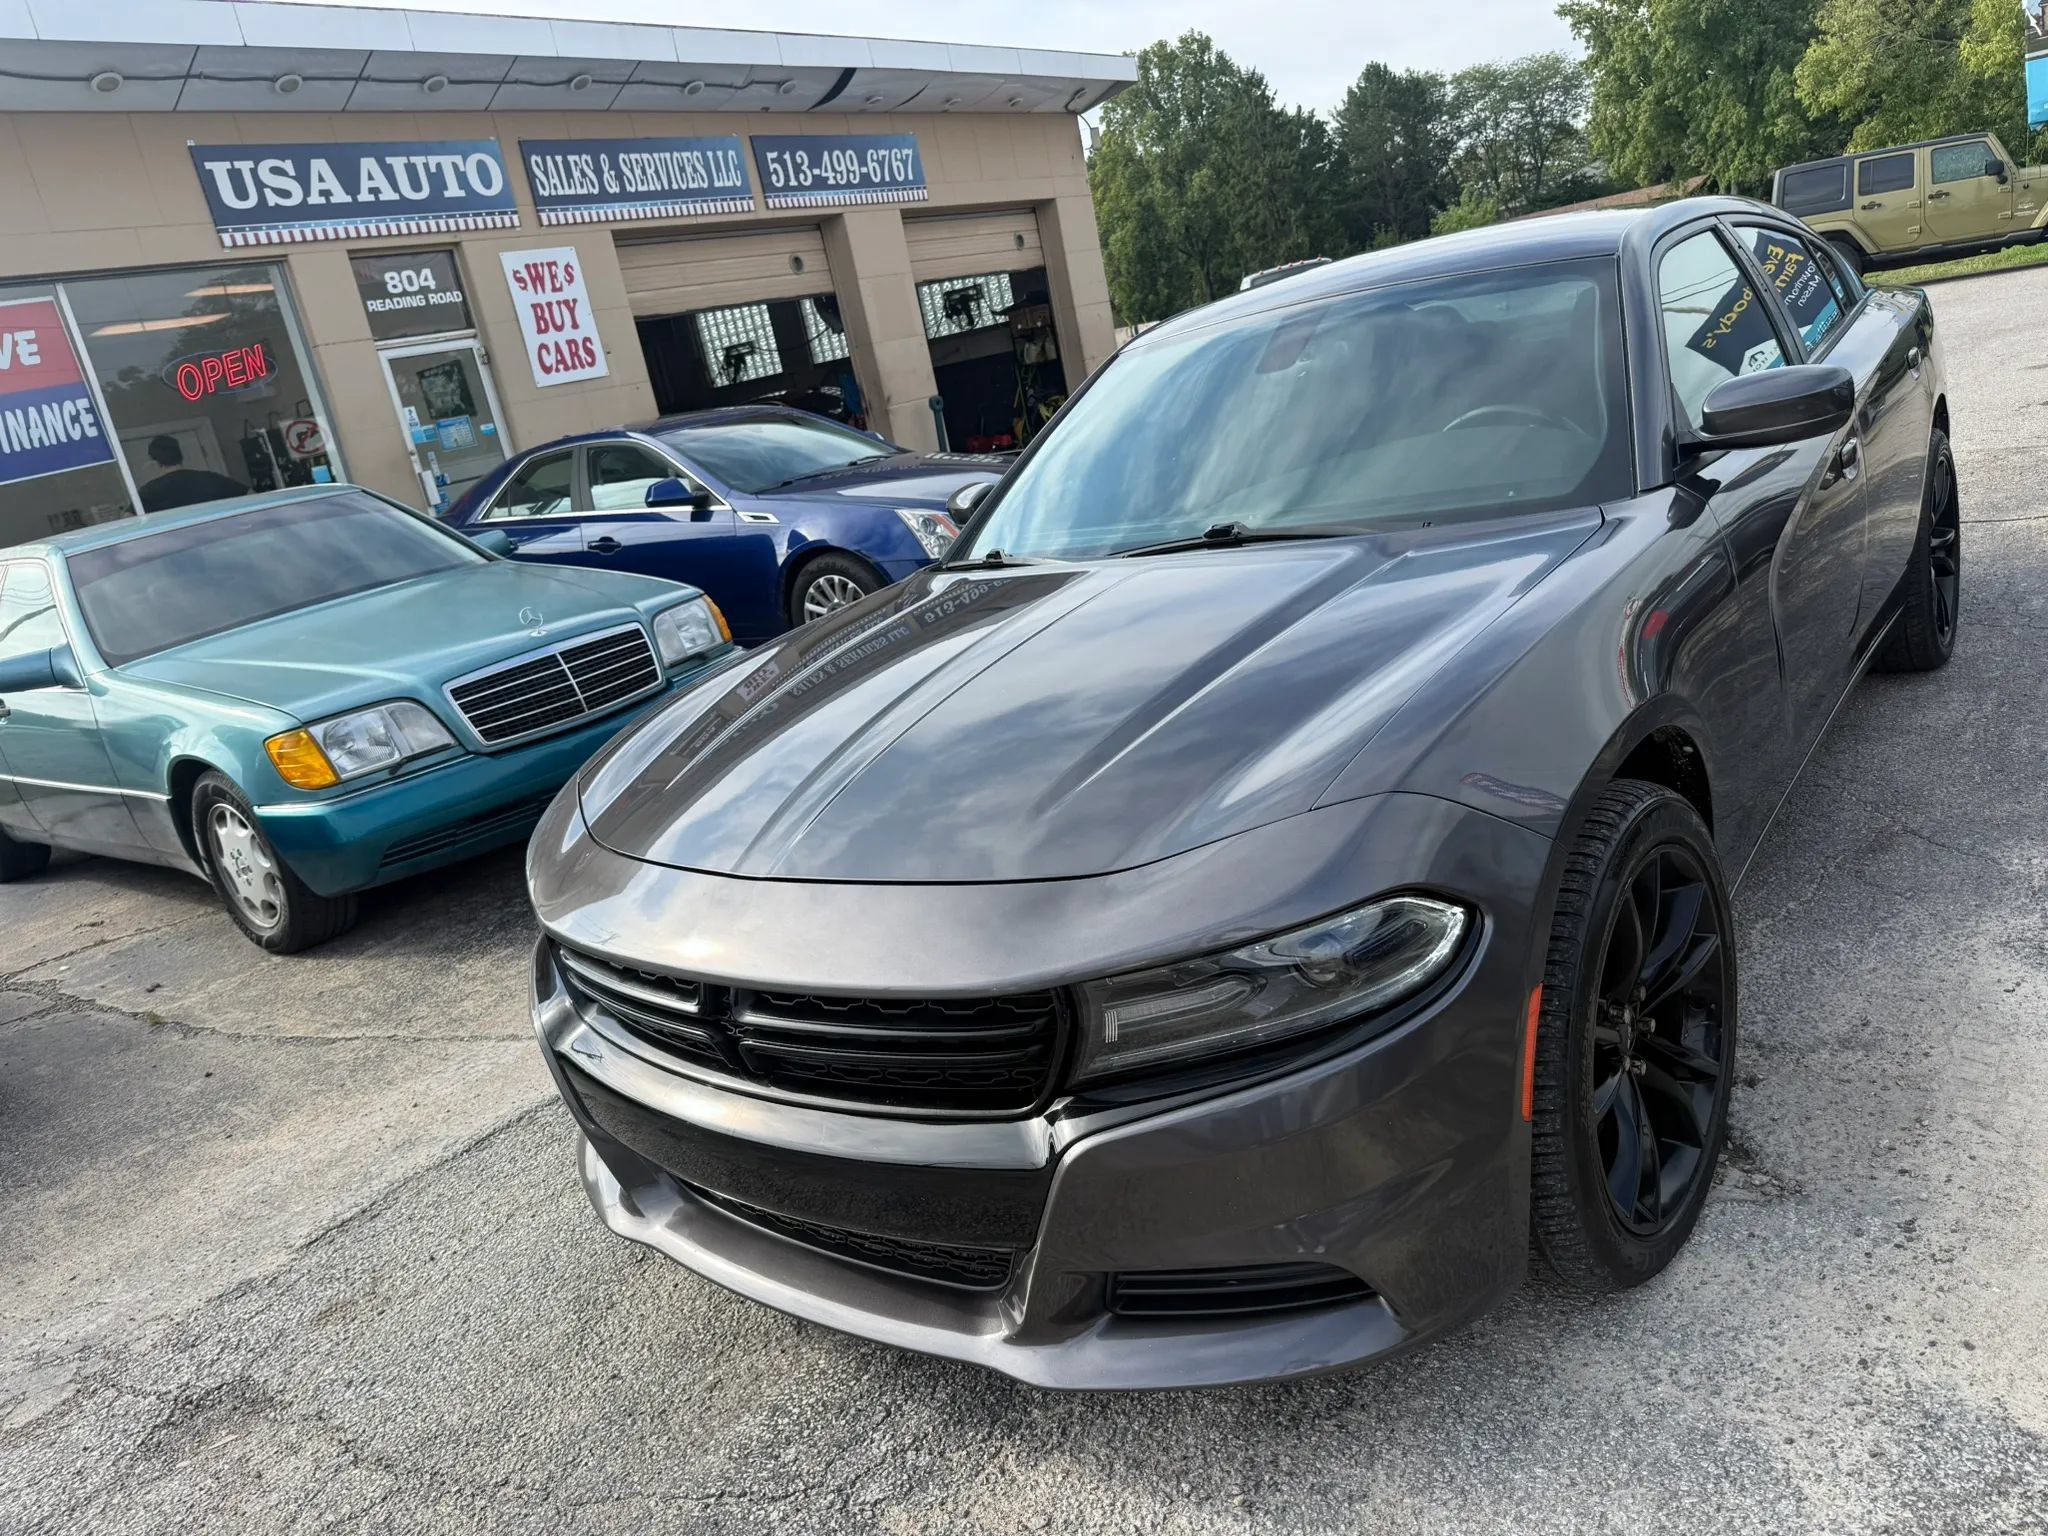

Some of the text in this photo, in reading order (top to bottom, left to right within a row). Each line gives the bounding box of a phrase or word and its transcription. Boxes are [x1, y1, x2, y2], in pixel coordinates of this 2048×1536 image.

[203, 152, 504, 210] USA AUTO
[530, 150, 742, 197] SALES & SERVICES LLC
[766, 148, 914, 188] 513-499-6767
[384, 268, 436, 294] 804
[366, 290, 463, 312] READING ROAD
[530, 298, 580, 335] BUY
[177, 344, 267, 401] OPEN
[537, 336, 597, 375] CARS
